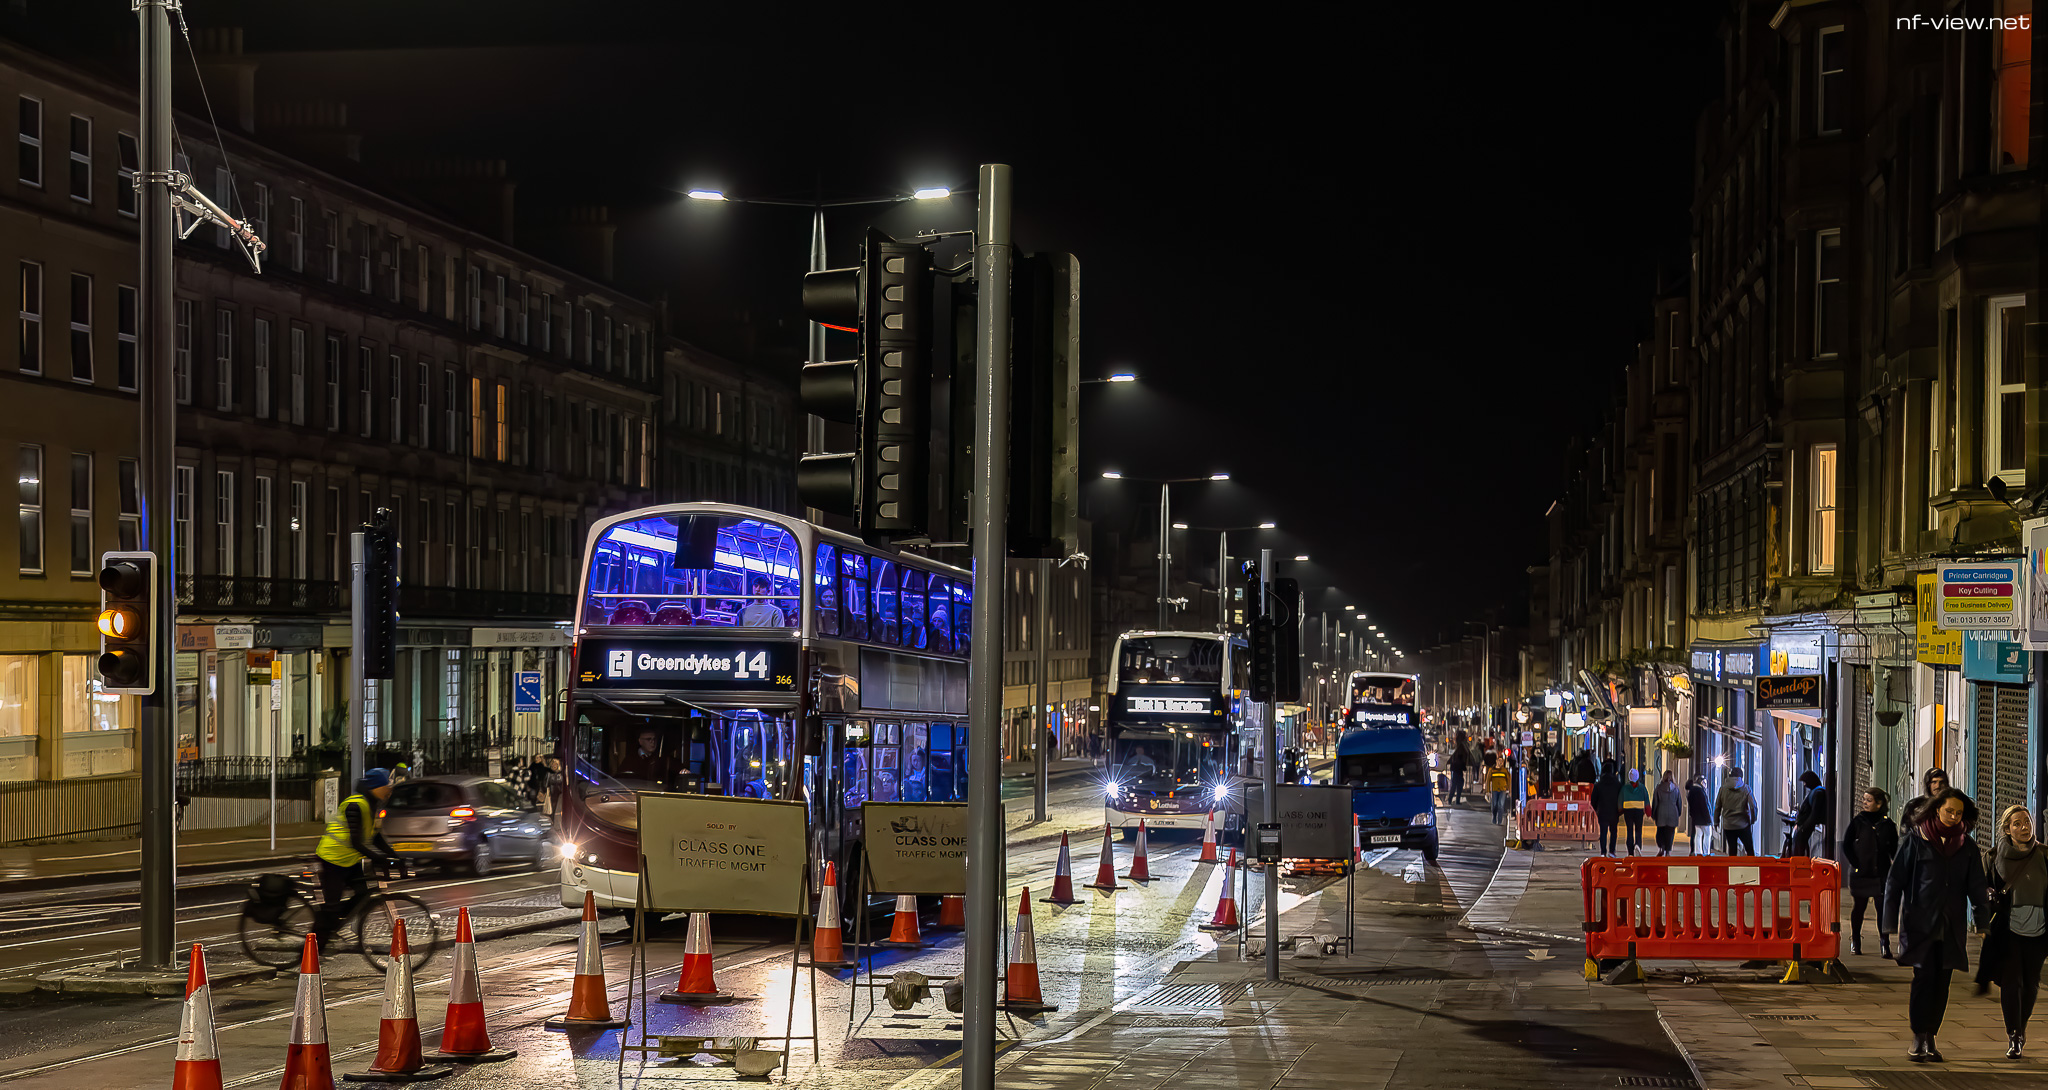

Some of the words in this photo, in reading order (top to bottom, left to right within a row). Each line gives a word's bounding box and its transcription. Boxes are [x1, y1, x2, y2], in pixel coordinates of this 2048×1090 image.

[1972, 572, 2008, 580] Cartridges
[1958, 587, 1972, 595] Key
[1973, 587, 1998, 595] Cutting
[637, 653, 731, 675] Greendykes
[734, 651, 768, 679] 14
[775, 675, 792, 685] 366
[1759, 677, 1816, 700] Slumdog
[1397, 712, 1407, 724] 11
[1278, 811, 1304, 819] LASS
[1306, 811, 1328, 819] ONE
[706, 822, 724, 830] SOLD
[728, 823, 737, 831] BY
[895, 835, 937, 846] CLASS
[941, 836, 967, 847] ONE
[678, 839, 728, 855] CLASS
[732, 843, 766, 857] ONE
[895, 850, 936, 859] TRAFFIC
[678, 857, 727, 871] TRAFFIC
[730, 860, 767, 872] MGMT
